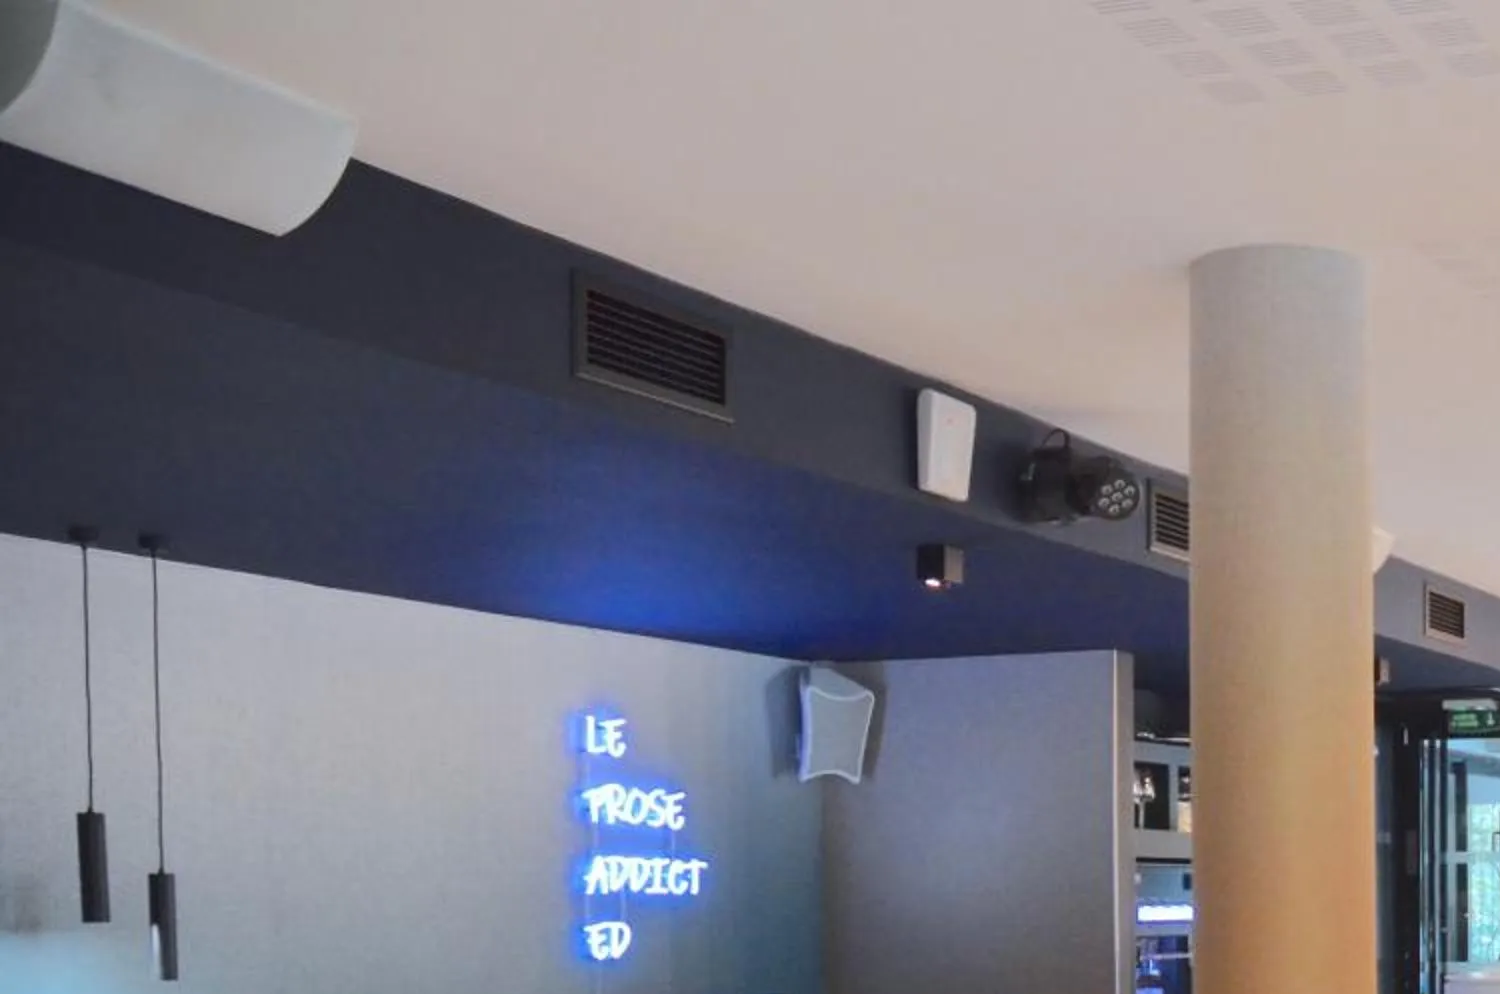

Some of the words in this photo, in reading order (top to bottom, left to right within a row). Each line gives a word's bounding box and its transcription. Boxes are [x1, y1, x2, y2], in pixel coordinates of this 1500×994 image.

[585, 714, 627, 758] LE
[585, 855, 709, 895] ADDICT
[584, 921, 631, 960] ED
